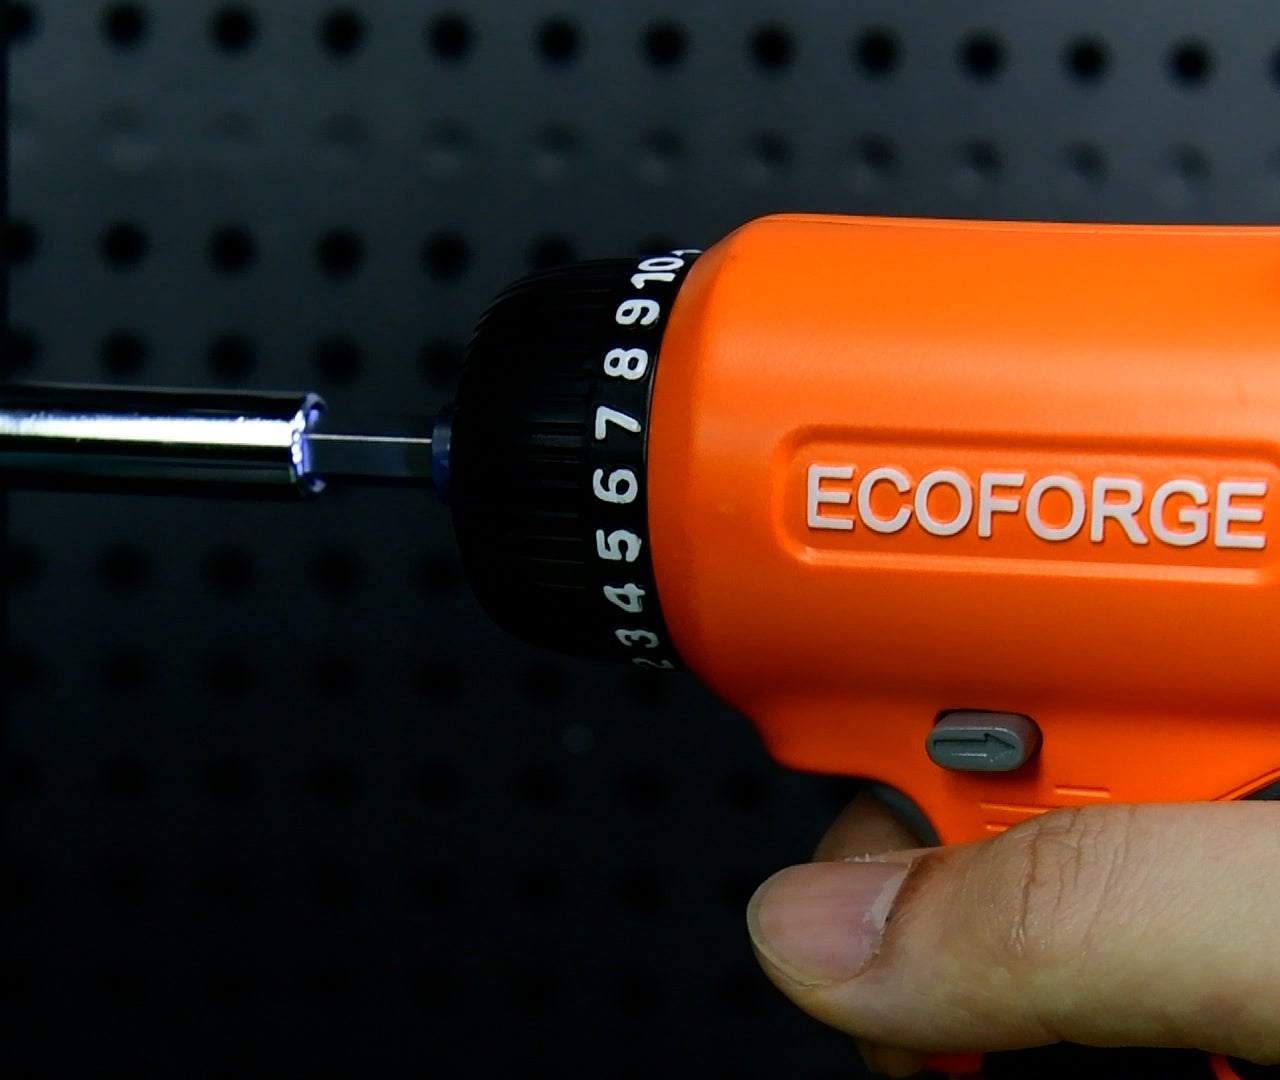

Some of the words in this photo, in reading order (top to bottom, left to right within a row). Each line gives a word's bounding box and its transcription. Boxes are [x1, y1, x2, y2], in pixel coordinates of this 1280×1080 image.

[630, 256, 685, 289] 10
[615, 299, 660, 326] 9
[604, 347, 649, 380] 8
[594, 406, 641, 440] 7
[593, 468, 639, 504] 6
[806, 463, 1268, 549] ECOFORGE
[595, 529, 642, 562] 5
[604, 583, 646, 613] 4
[615, 629, 659, 648] 3
